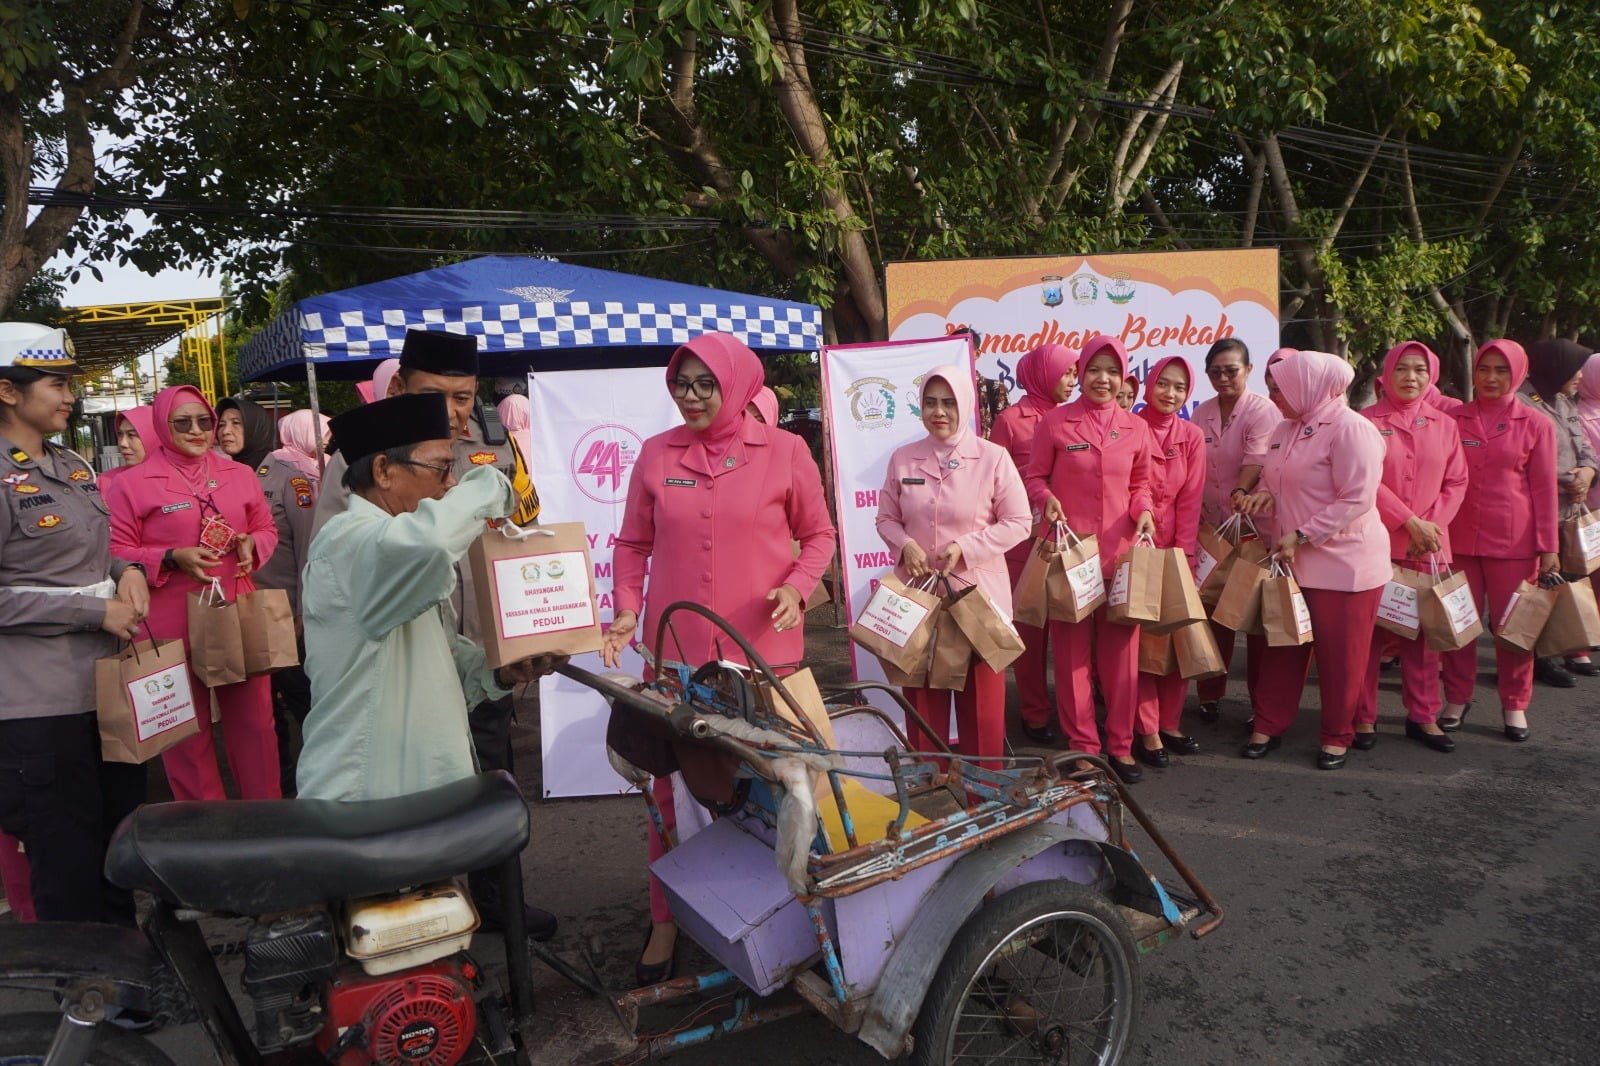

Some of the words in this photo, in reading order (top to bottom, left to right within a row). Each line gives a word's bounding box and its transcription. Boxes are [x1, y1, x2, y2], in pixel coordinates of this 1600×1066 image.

[533, 616, 565, 628] PEDULI
[157, 715, 178, 728] PEDULI
[401, 1027, 435, 1040] HONDA
